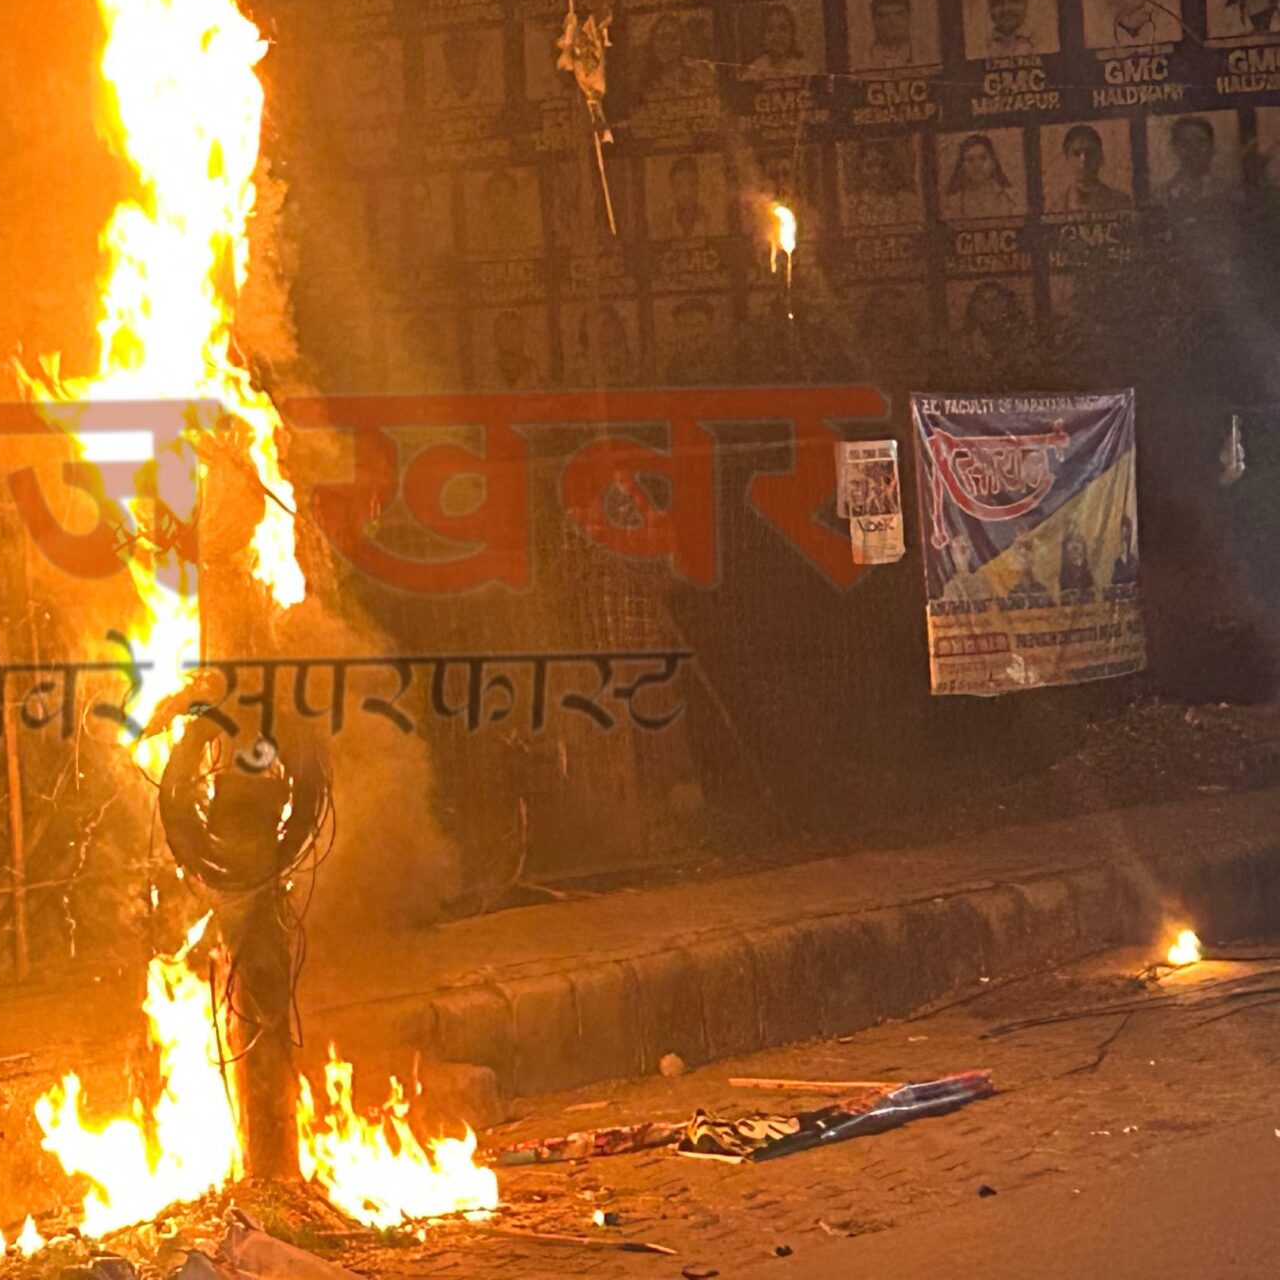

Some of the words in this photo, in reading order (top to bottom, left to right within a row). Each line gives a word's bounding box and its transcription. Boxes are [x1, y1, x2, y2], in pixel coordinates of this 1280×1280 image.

[1104, 56, 1169, 84] GMC
[1228, 48, 1280, 74] GM
[867, 80, 928, 106] GMC
[983, 68, 1047, 96] GMC
[955, 230, 1018, 255] GMC
[943, 398, 994, 416] FACULTY
